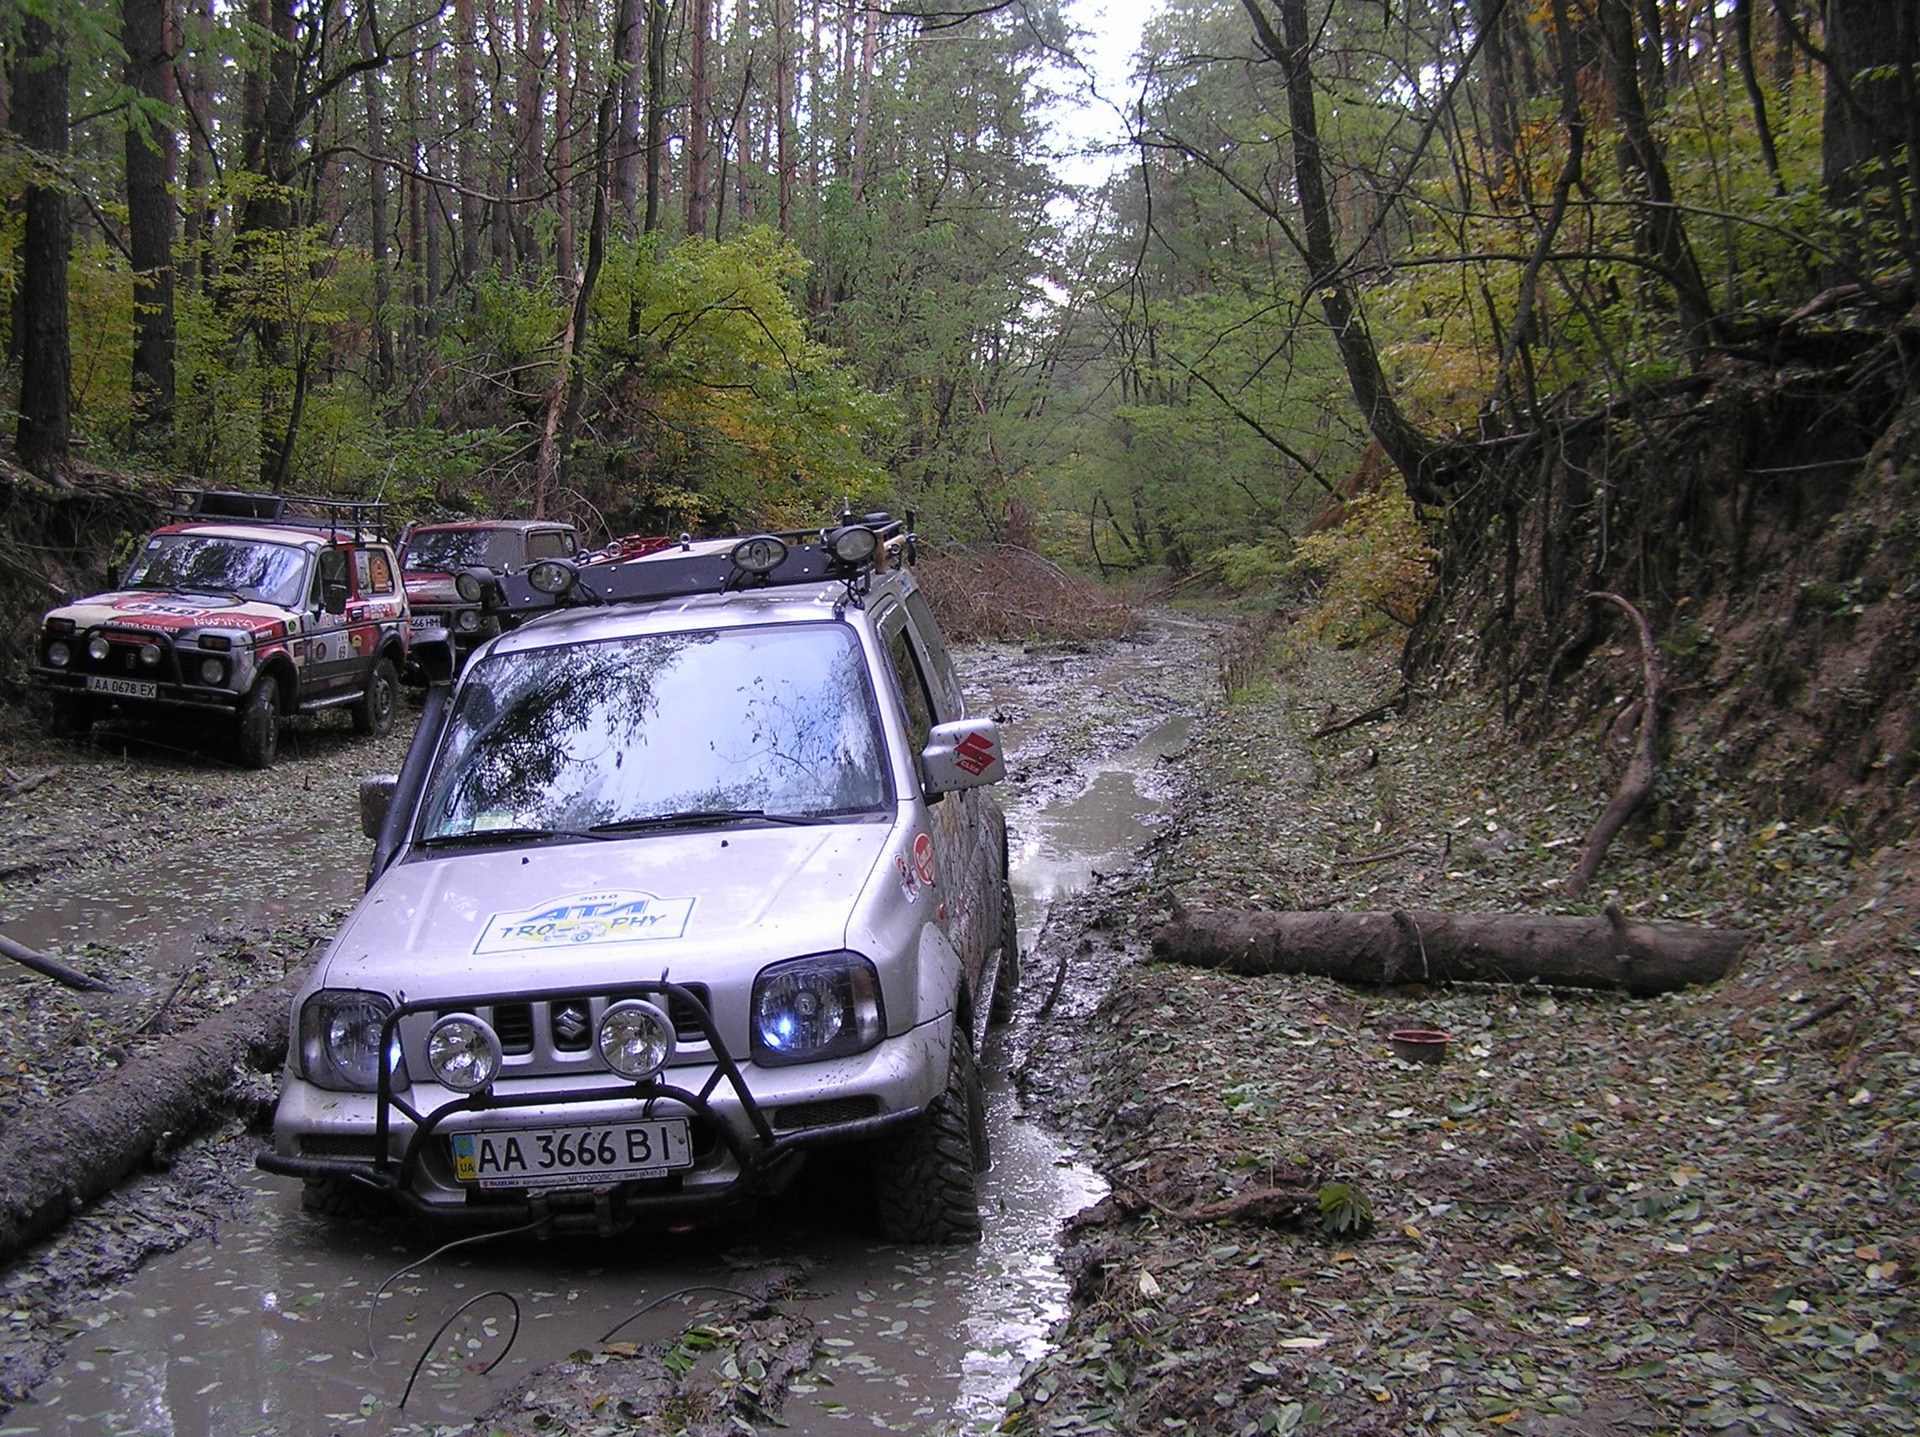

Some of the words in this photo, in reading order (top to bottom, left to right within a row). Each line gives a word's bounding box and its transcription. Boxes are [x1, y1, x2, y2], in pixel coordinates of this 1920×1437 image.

[95, 679, 109, 691] AA
[112, 681, 137, 695] 0678
[140, 684, 155, 697] EX
[579, 893, 618, 901] 2010
[515, 899, 650, 924] ATA
[478, 1136, 528, 1173] AA
[534, 1130, 617, 1168] 3666
[459, 1163, 475, 1173] UA
